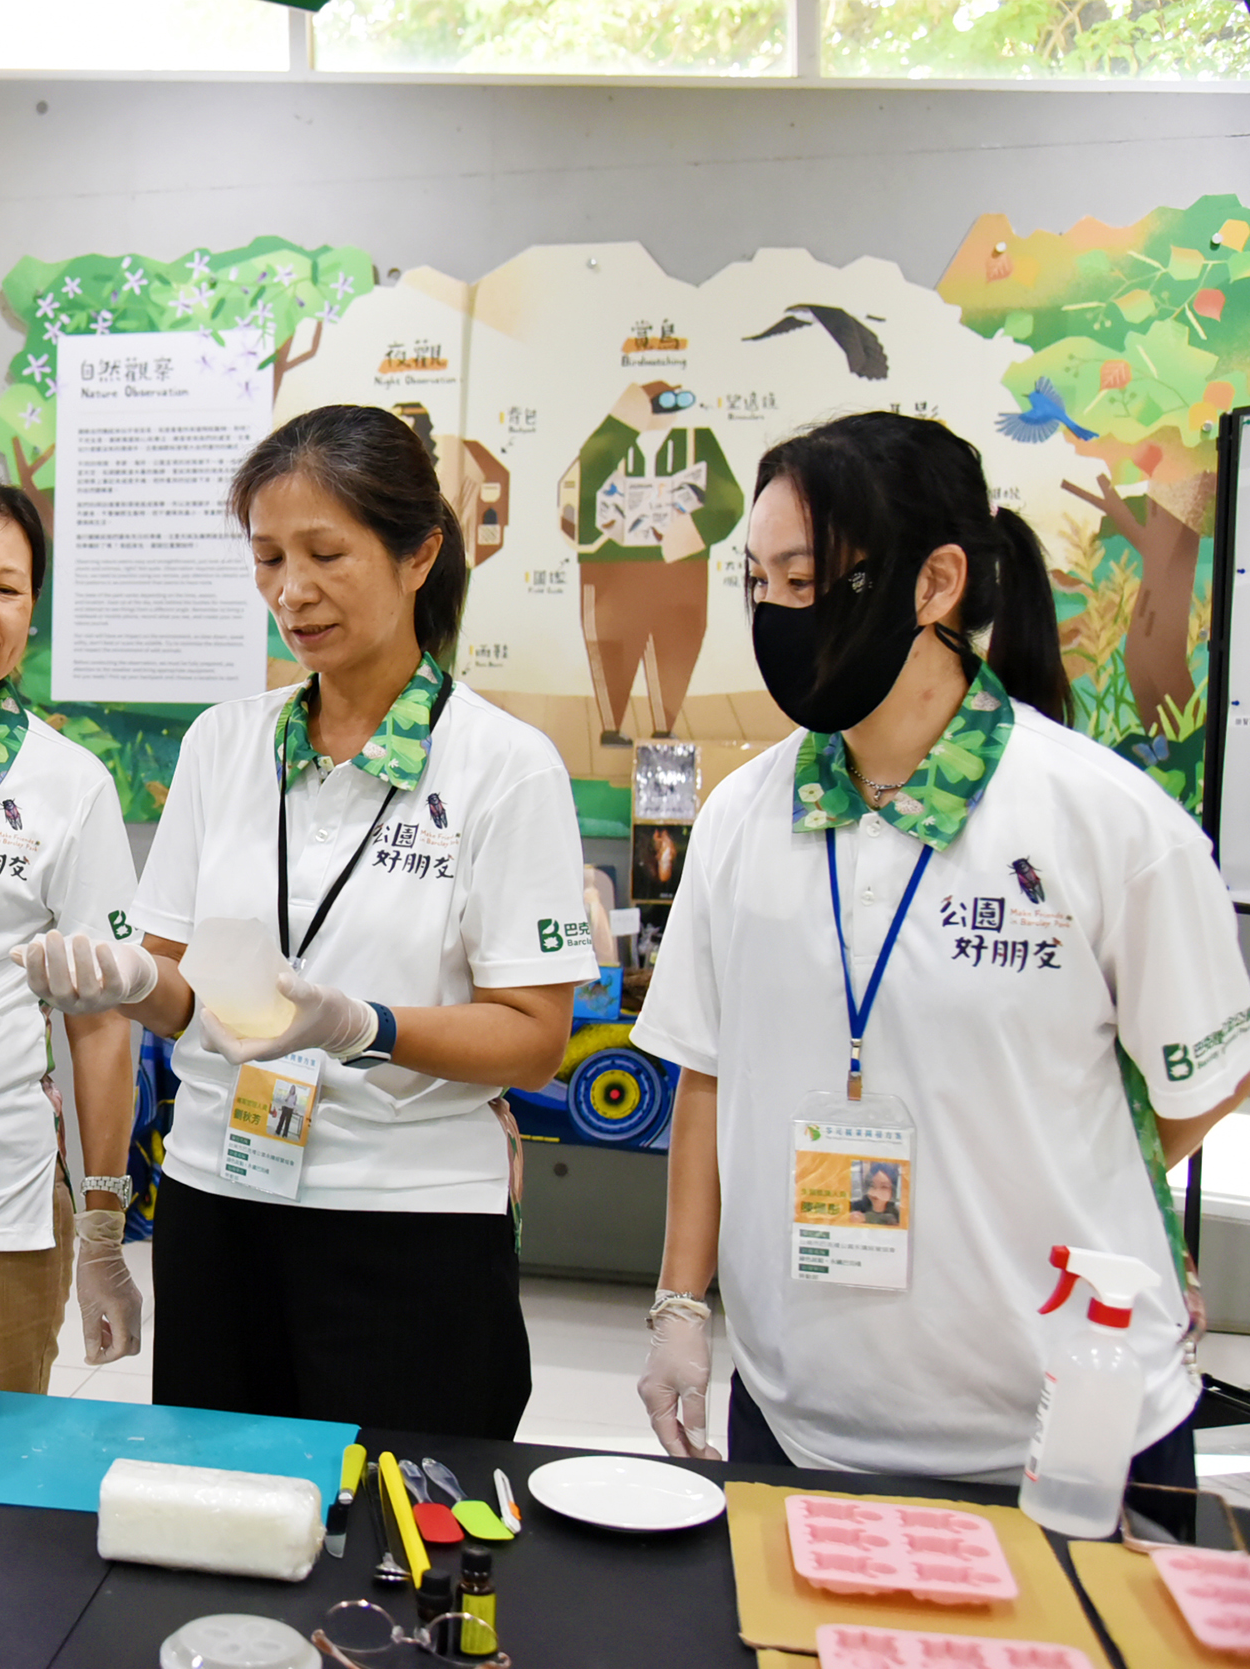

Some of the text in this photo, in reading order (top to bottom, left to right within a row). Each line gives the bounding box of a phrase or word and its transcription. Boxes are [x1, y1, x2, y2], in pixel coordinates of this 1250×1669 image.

[632, 319, 680, 350] 賞鳥
[385, 339, 446, 368] 夜觀
[621, 355, 687, 369] Birdwatching
[80, 356, 174, 381] 自然觀察
[80, 385, 189, 399] Nature Observation
[374, 376, 401, 390] Night
[2, 838, 24, 849] Barclay
[25, 843, 39, 852] Park
[13, 834, 34, 844] Friends
[372, 823, 419, 849] 公園
[426, 838, 449, 848] Barclay
[372, 850, 454, 880] 好朋友
[940, 897, 1005, 933] 公園
[951, 935, 1062, 973] 好朋友
